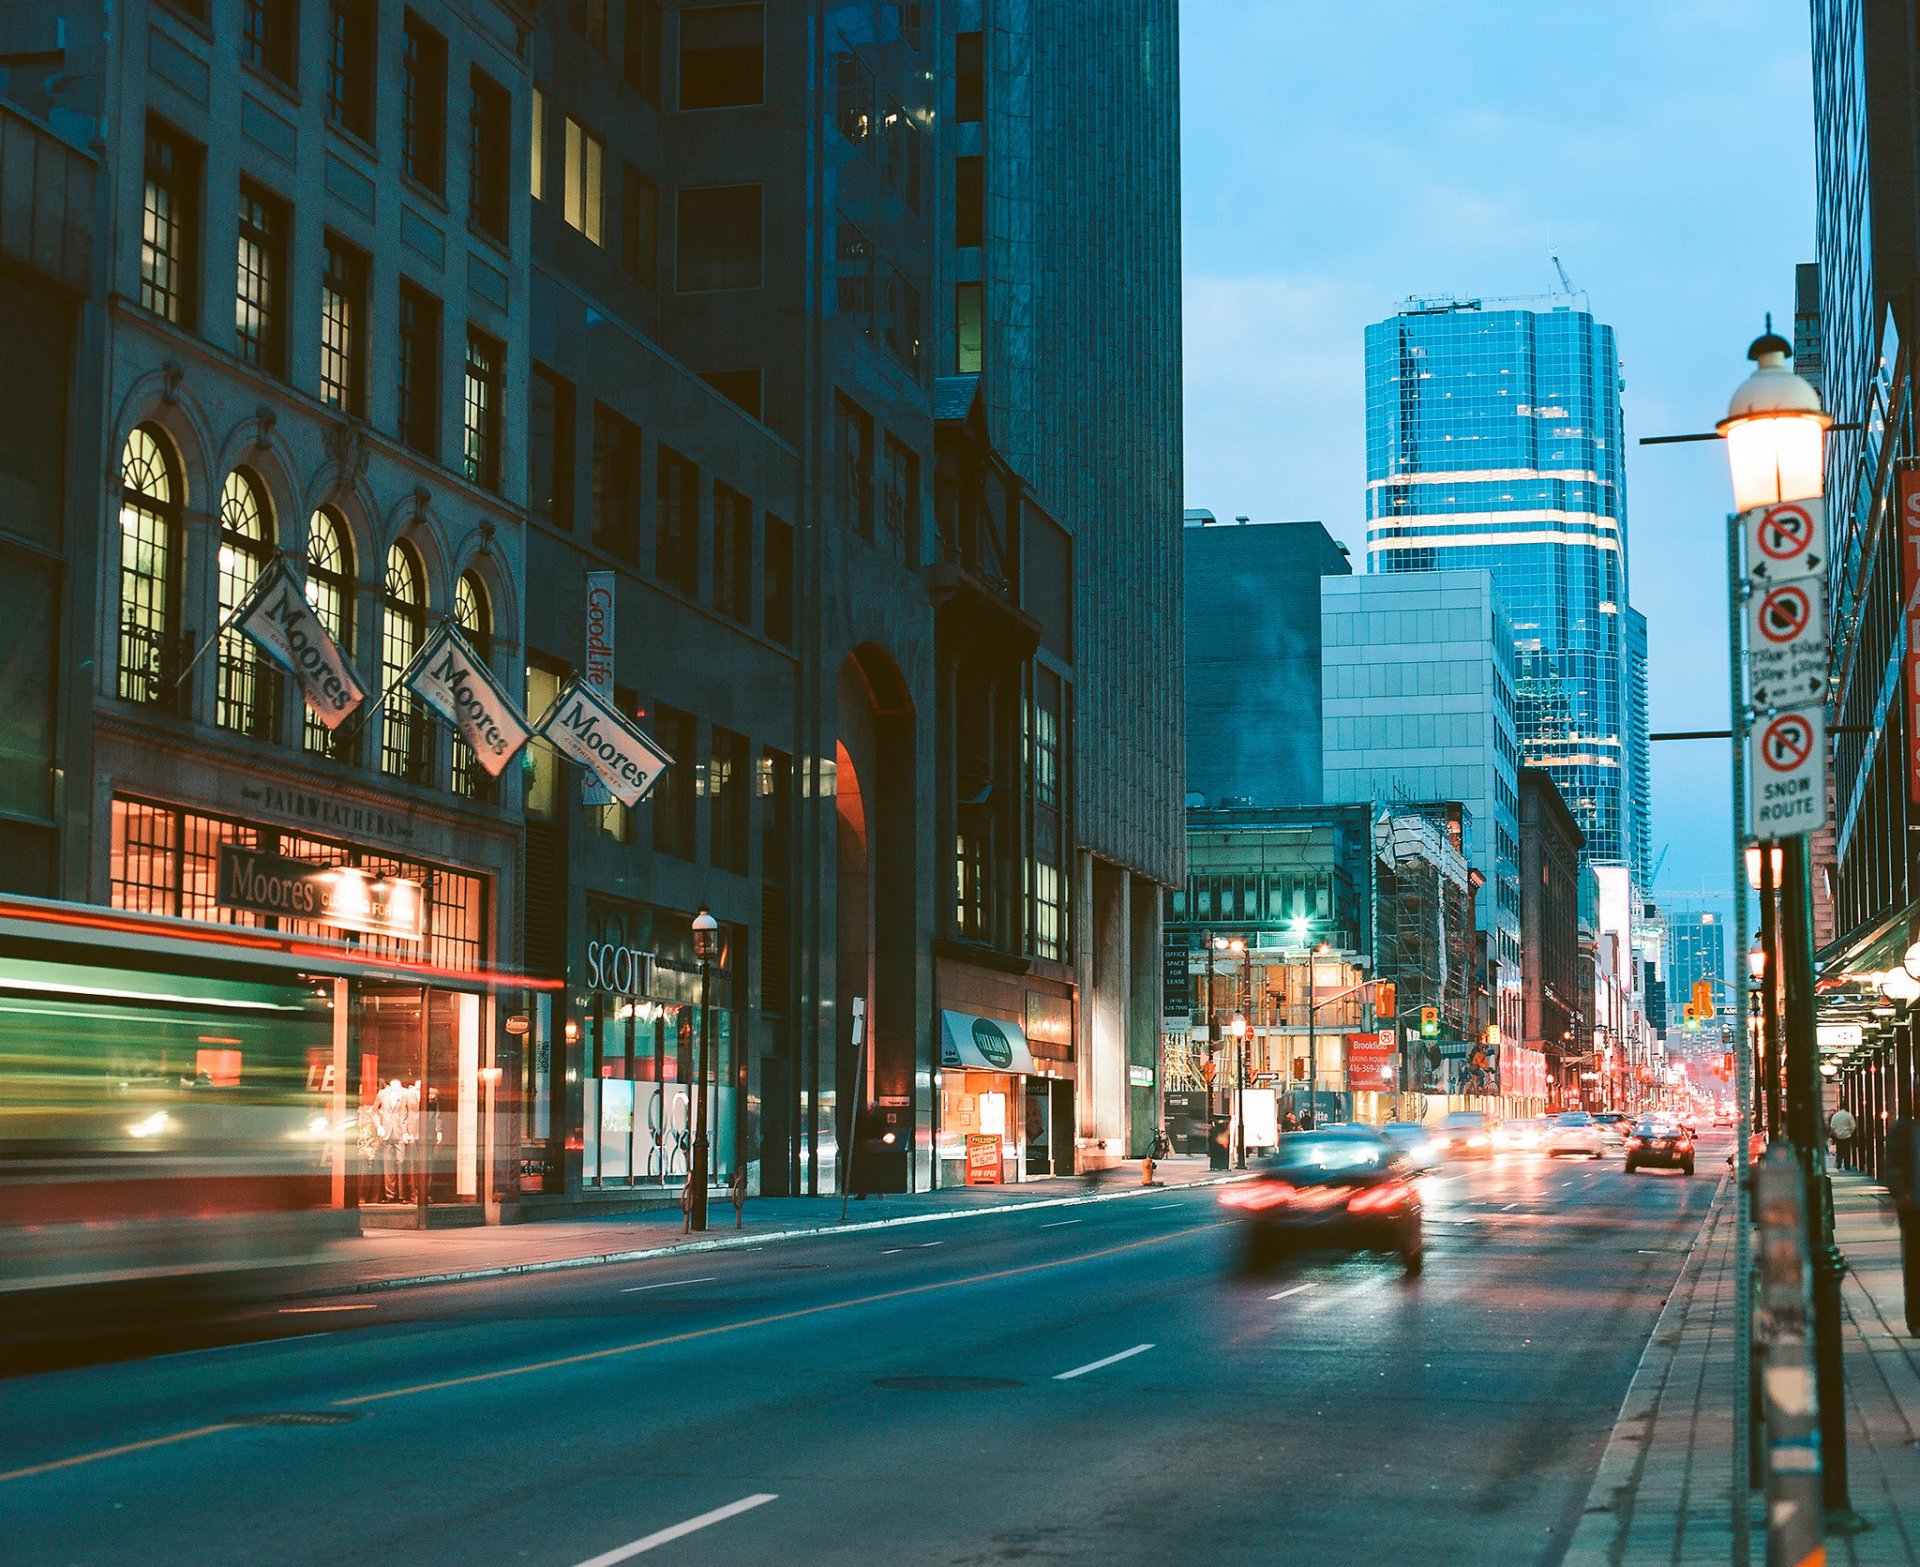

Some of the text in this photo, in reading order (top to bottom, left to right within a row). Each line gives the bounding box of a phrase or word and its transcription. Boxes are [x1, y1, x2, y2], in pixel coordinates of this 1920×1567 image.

[264, 585, 350, 711] Moores
[587, 588, 613, 686] GoodLife
[430, 650, 508, 756] Moores
[560, 699, 648, 789] Moores
[1759, 796, 1815, 822] ROUTE
[1764, 776, 1812, 799] SNOW
[230, 854, 314, 913] Moores
[372, 902, 392, 917] FOR
[587, 940, 656, 997] SCOTT
[505, 1018, 529, 1028] Moores
[1026, 1084, 1047, 1093] ental
